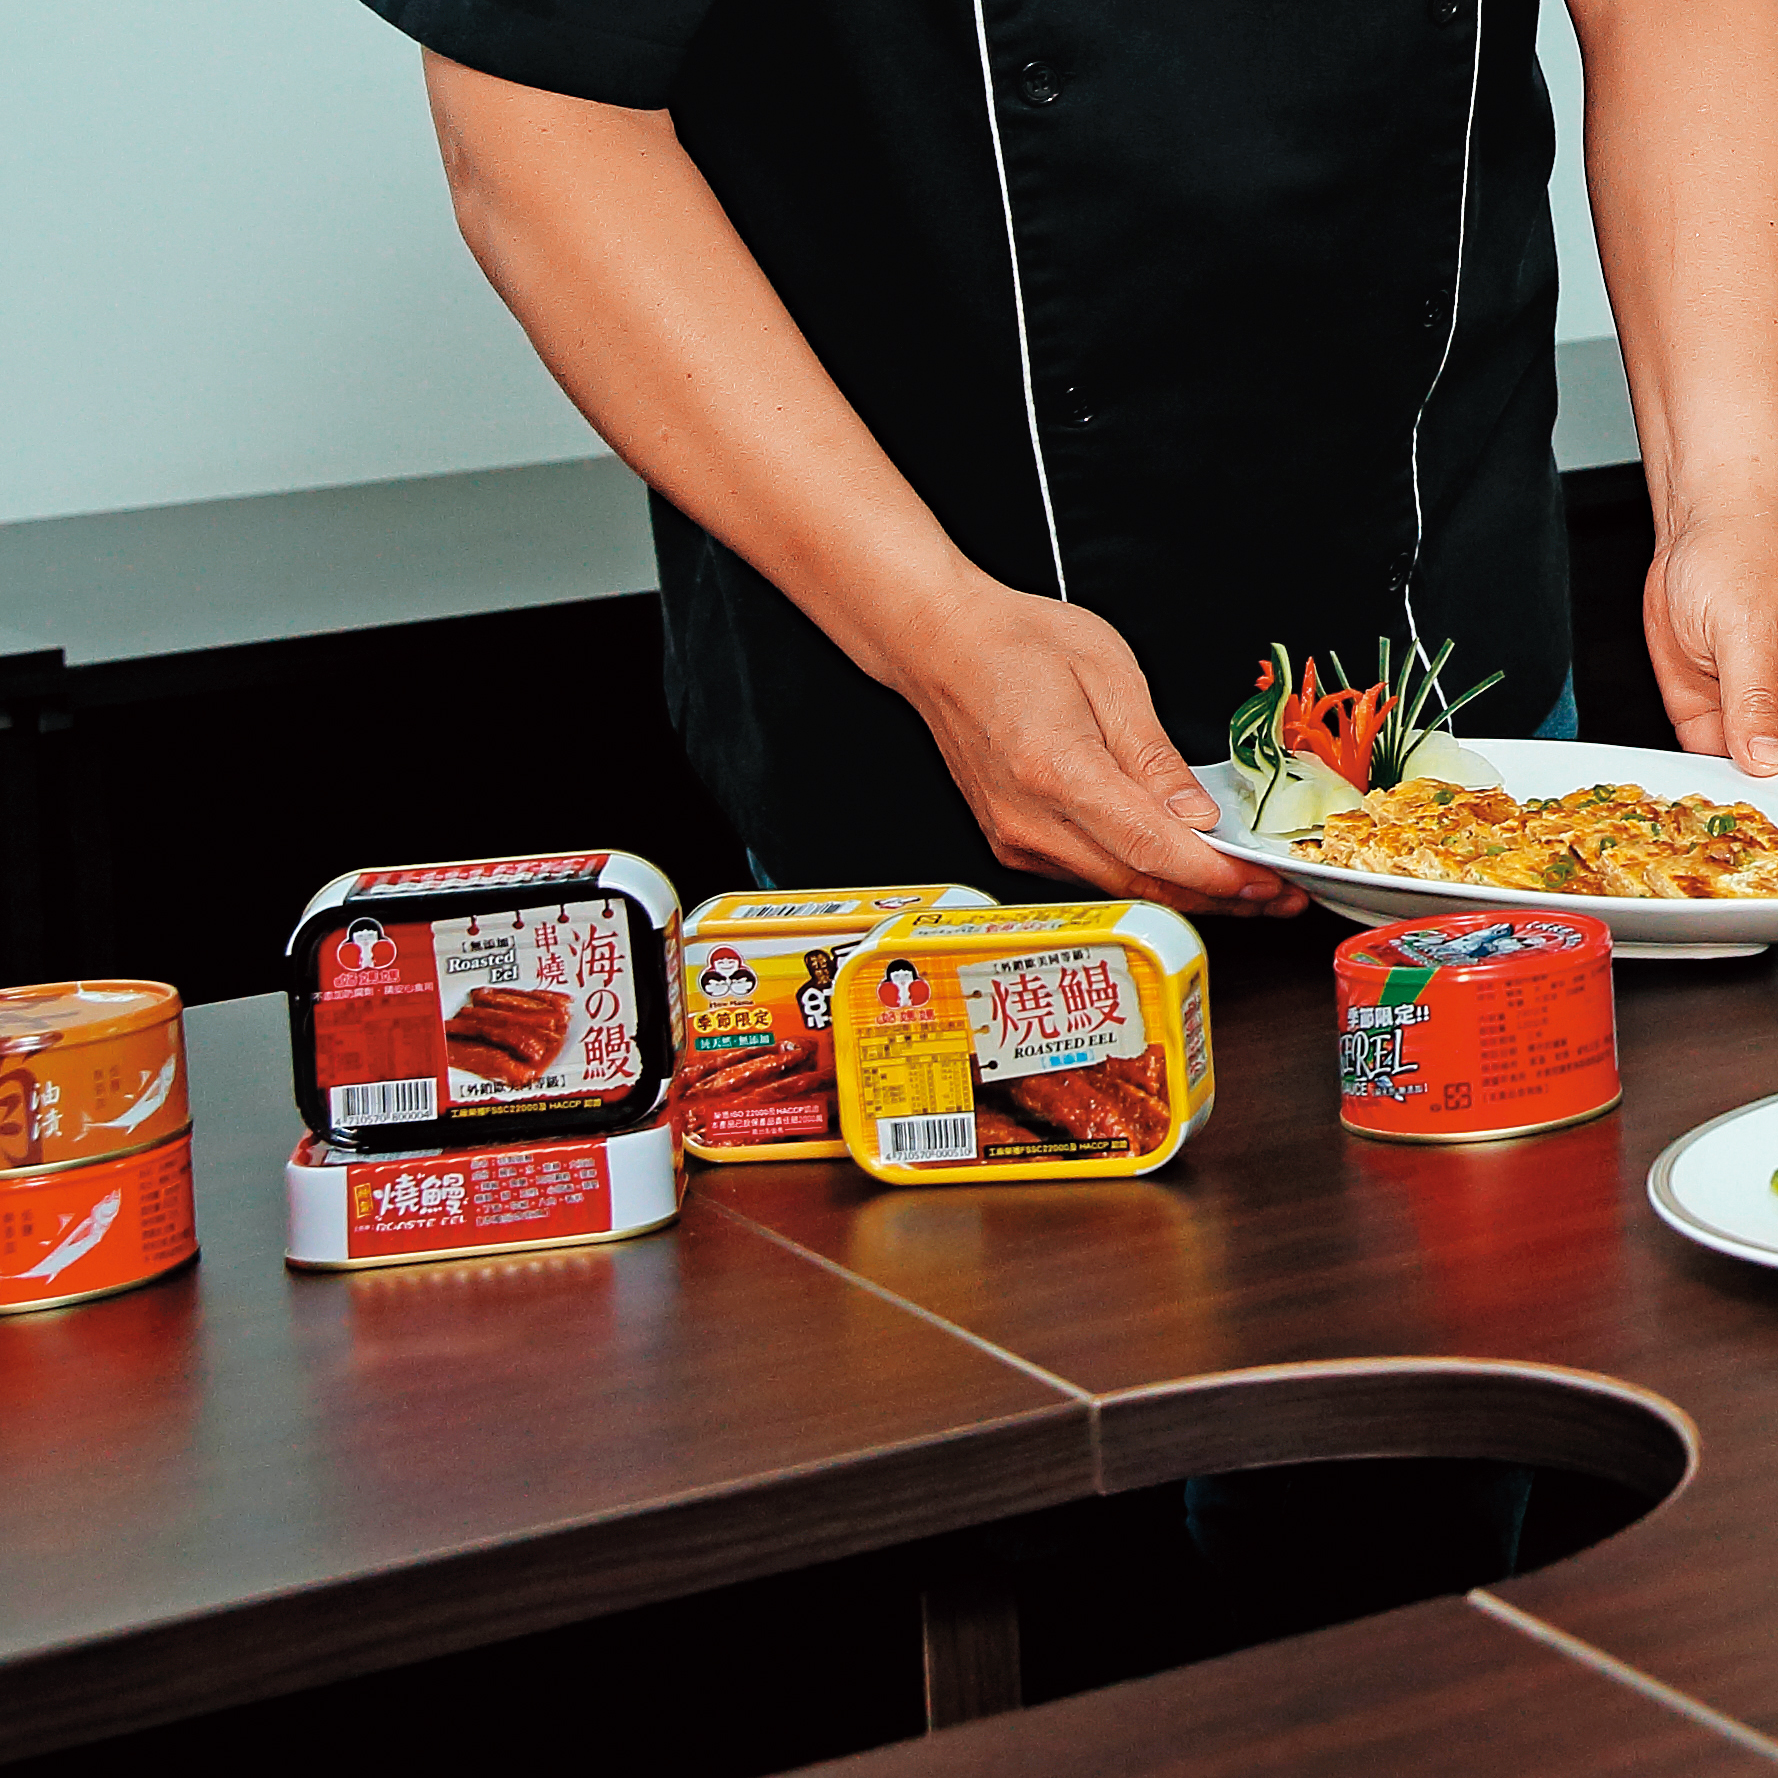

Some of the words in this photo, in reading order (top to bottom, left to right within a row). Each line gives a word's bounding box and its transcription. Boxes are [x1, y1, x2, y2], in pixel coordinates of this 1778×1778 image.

[447, 948, 516, 973] Roasted
[534, 922, 569, 990] 串燒
[489, 965, 519, 984] Eel
[566, 923, 636, 1082] 海の鰻
[991, 960, 1127, 1049] 燒鰻
[697, 1008, 770, 1032] 季節限定
[1014, 1037, 1085, 1059] ROASTED
[1089, 1032, 1118, 1047] EEL
[29, 1080, 63, 1141] 油漬
[550, 1100, 582, 1108] HACCP
[1079, 1141, 1109, 1150] HACCP
[373, 1173, 467, 1217] 燒鰻
